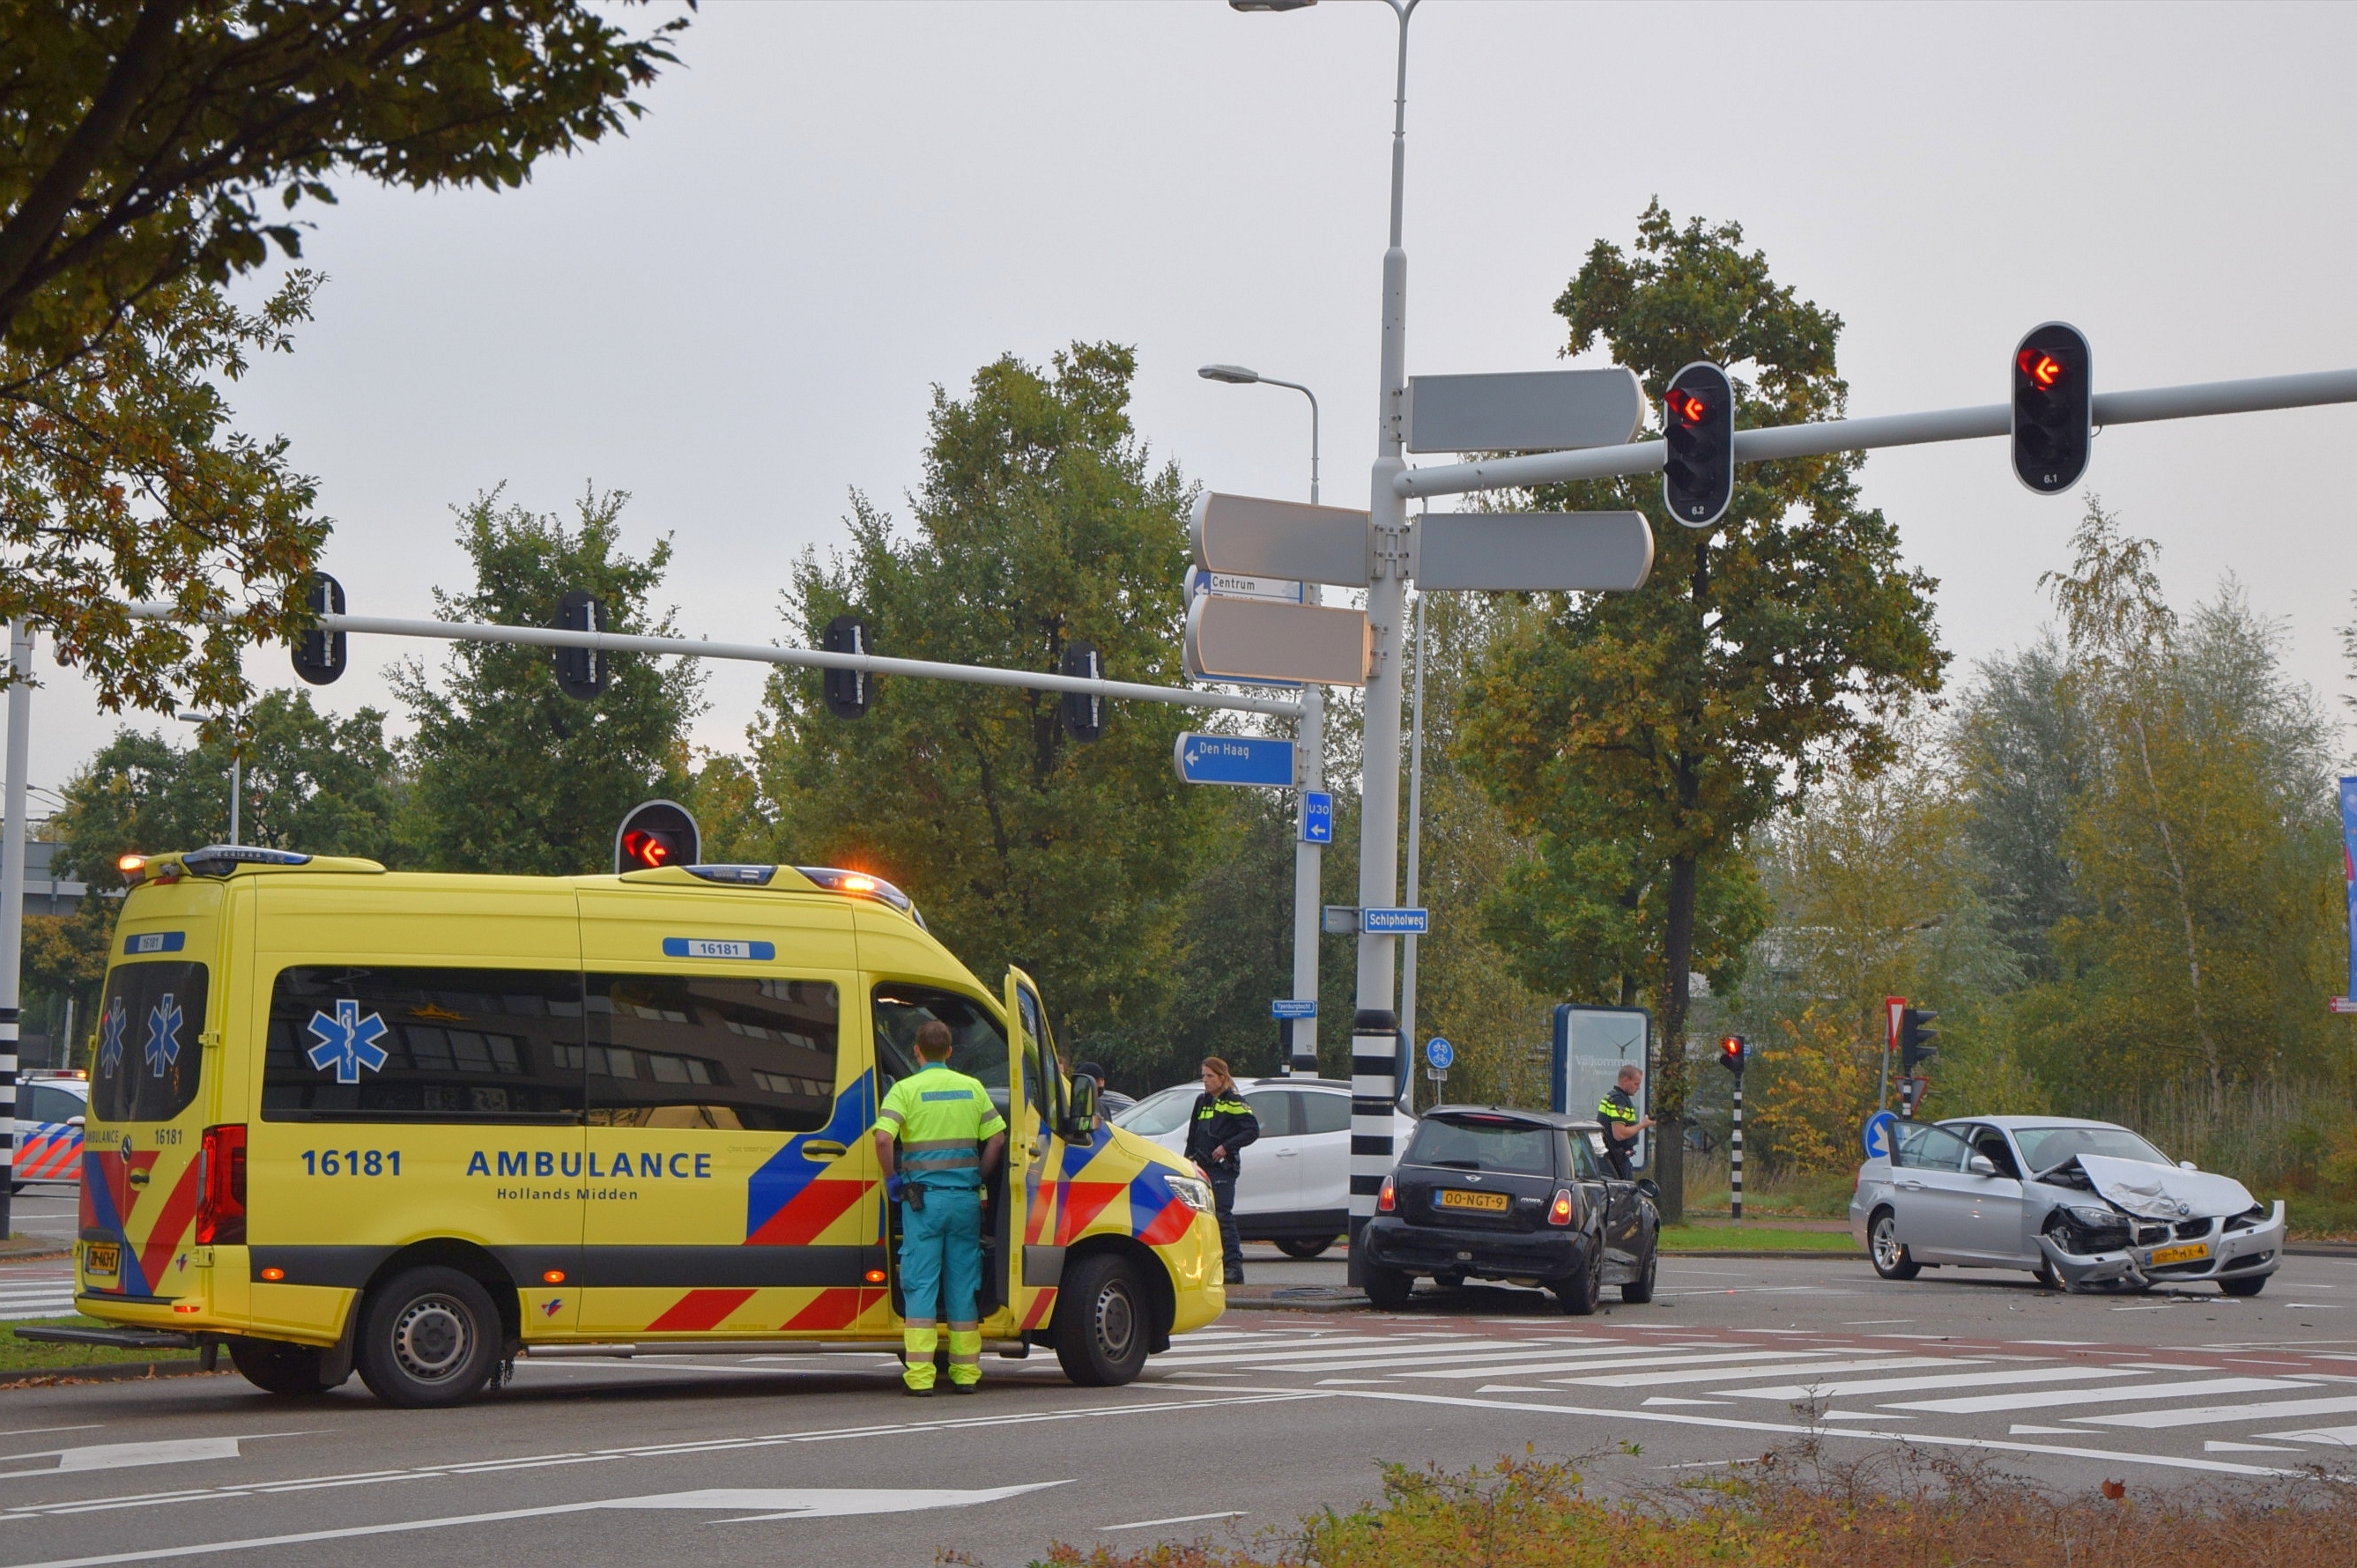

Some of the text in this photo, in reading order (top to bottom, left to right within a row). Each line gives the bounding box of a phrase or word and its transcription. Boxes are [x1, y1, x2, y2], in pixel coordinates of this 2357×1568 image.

[2044, 473, 2057, 484] 6.1
[1692, 505, 1705, 515] 6.2
[1212, 575, 1256, 591] Centrum
[1199, 741, 1249, 760] Den Haag
[1308, 803, 1330, 815] U30
[1369, 913, 1424, 929] Schipholweg
[143, 936, 159, 950] 16181
[699, 943, 738, 956] 16181
[1575, 1054, 1638, 1068] Välkommen
[85, 1129, 119, 1144] AMBULANCE
[155, 1128, 183, 1145] 16181
[300, 1149, 401, 1177] 16181
[466, 1150, 712, 1179] AMBULANCE
[496, 1187, 638, 1201] Hollands Midden
[1444, 1192, 1504, 1208] 00-NGT-9
